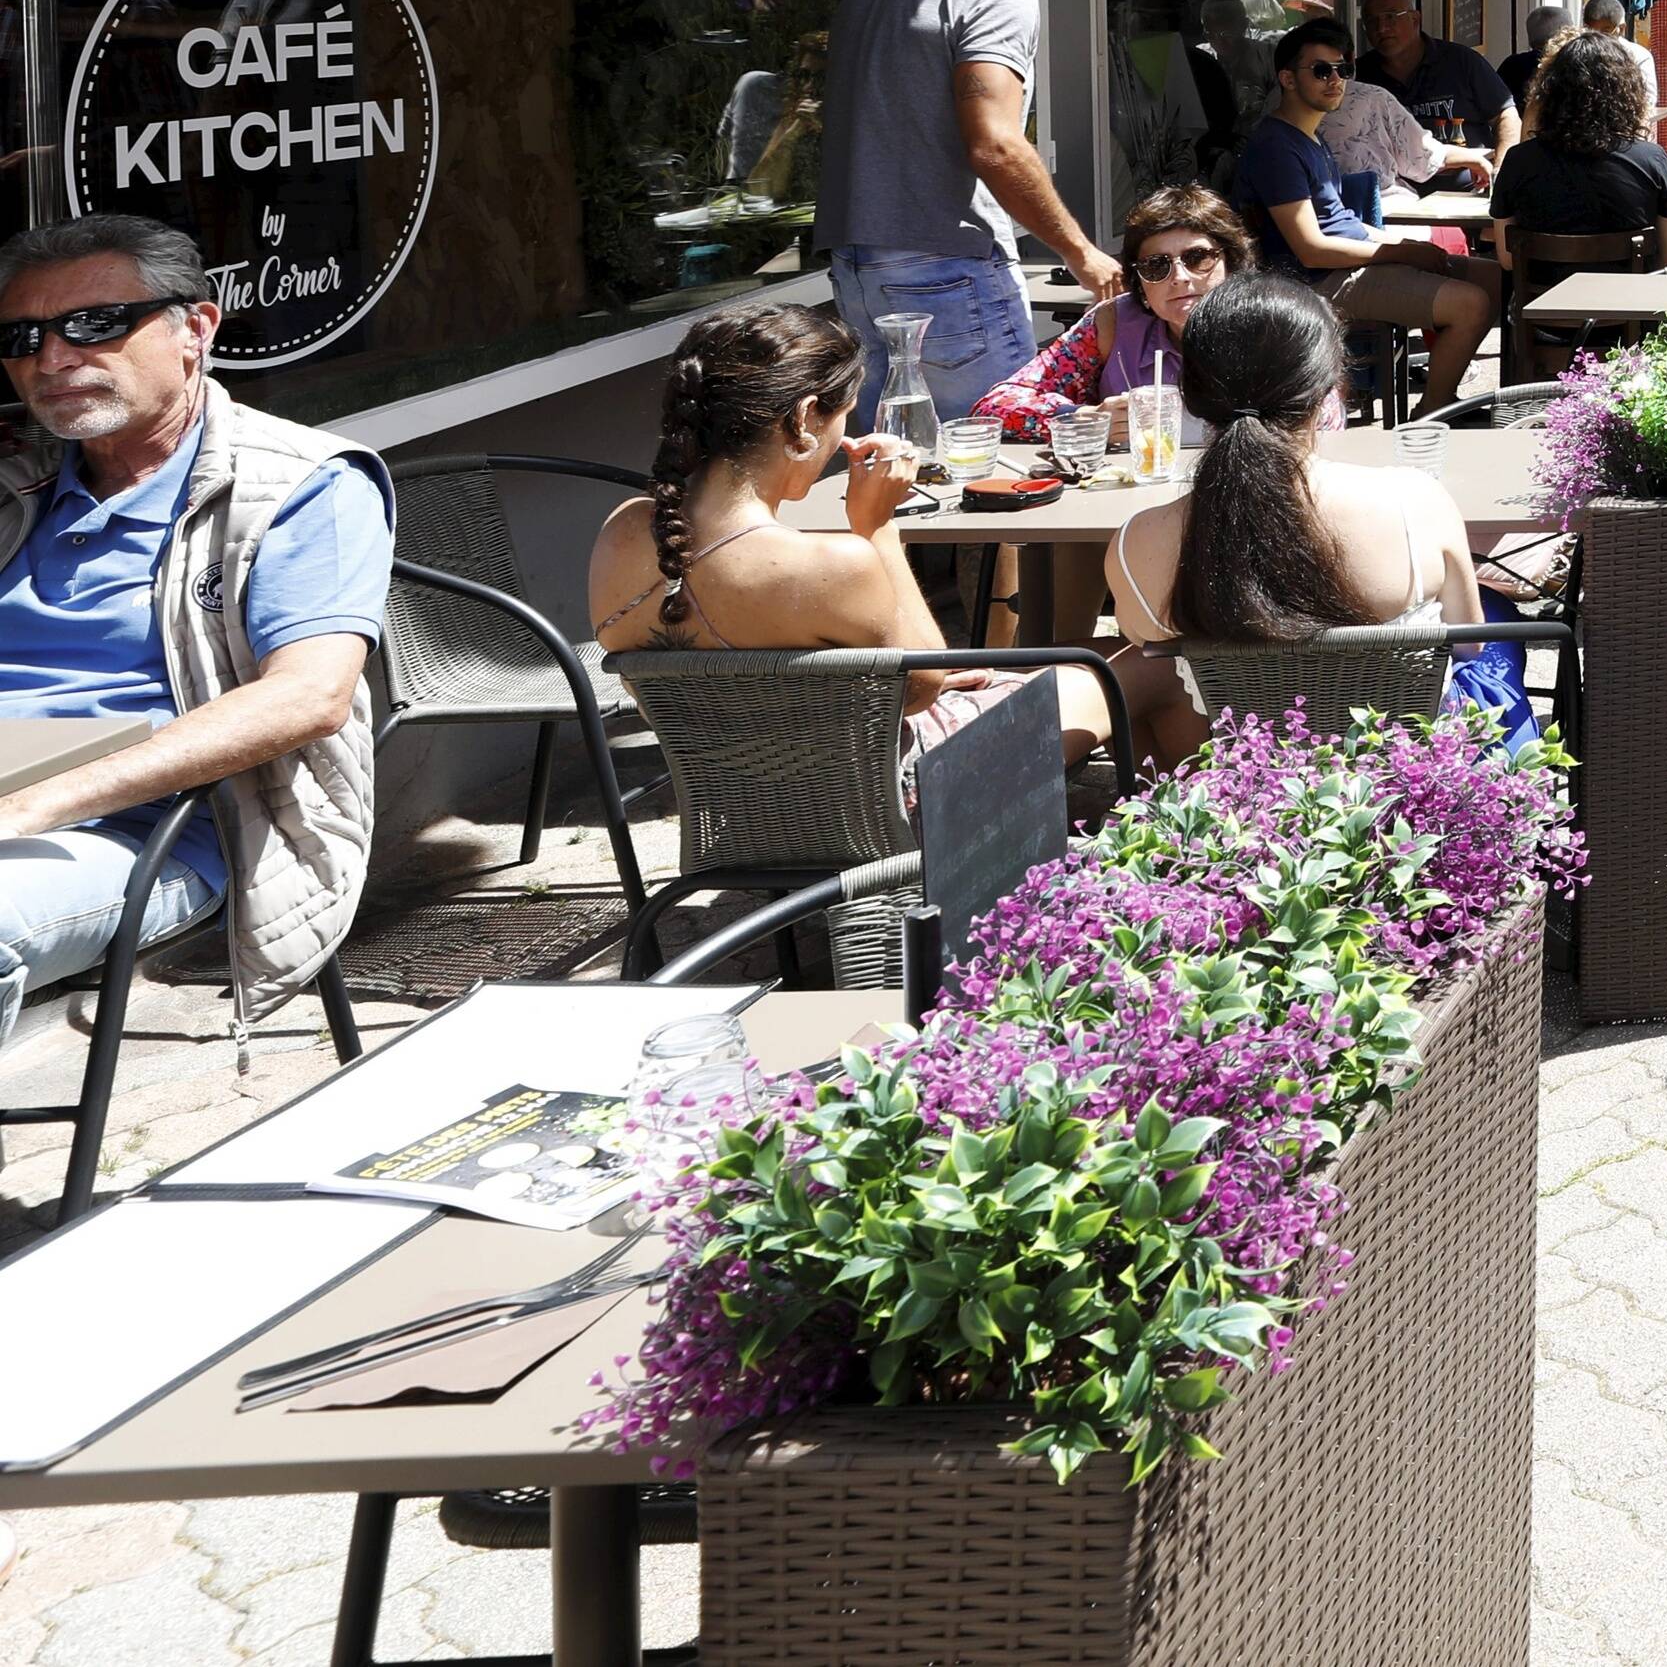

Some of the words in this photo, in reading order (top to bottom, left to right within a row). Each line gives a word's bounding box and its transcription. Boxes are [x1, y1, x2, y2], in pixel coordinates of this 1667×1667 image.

[177, 2, 355, 89] CAFÉ
[115, 98, 405, 189] KITCHEN
[262, 205, 286, 247] by
[205, 260, 256, 313] The
[258, 255, 343, 307] Corner
